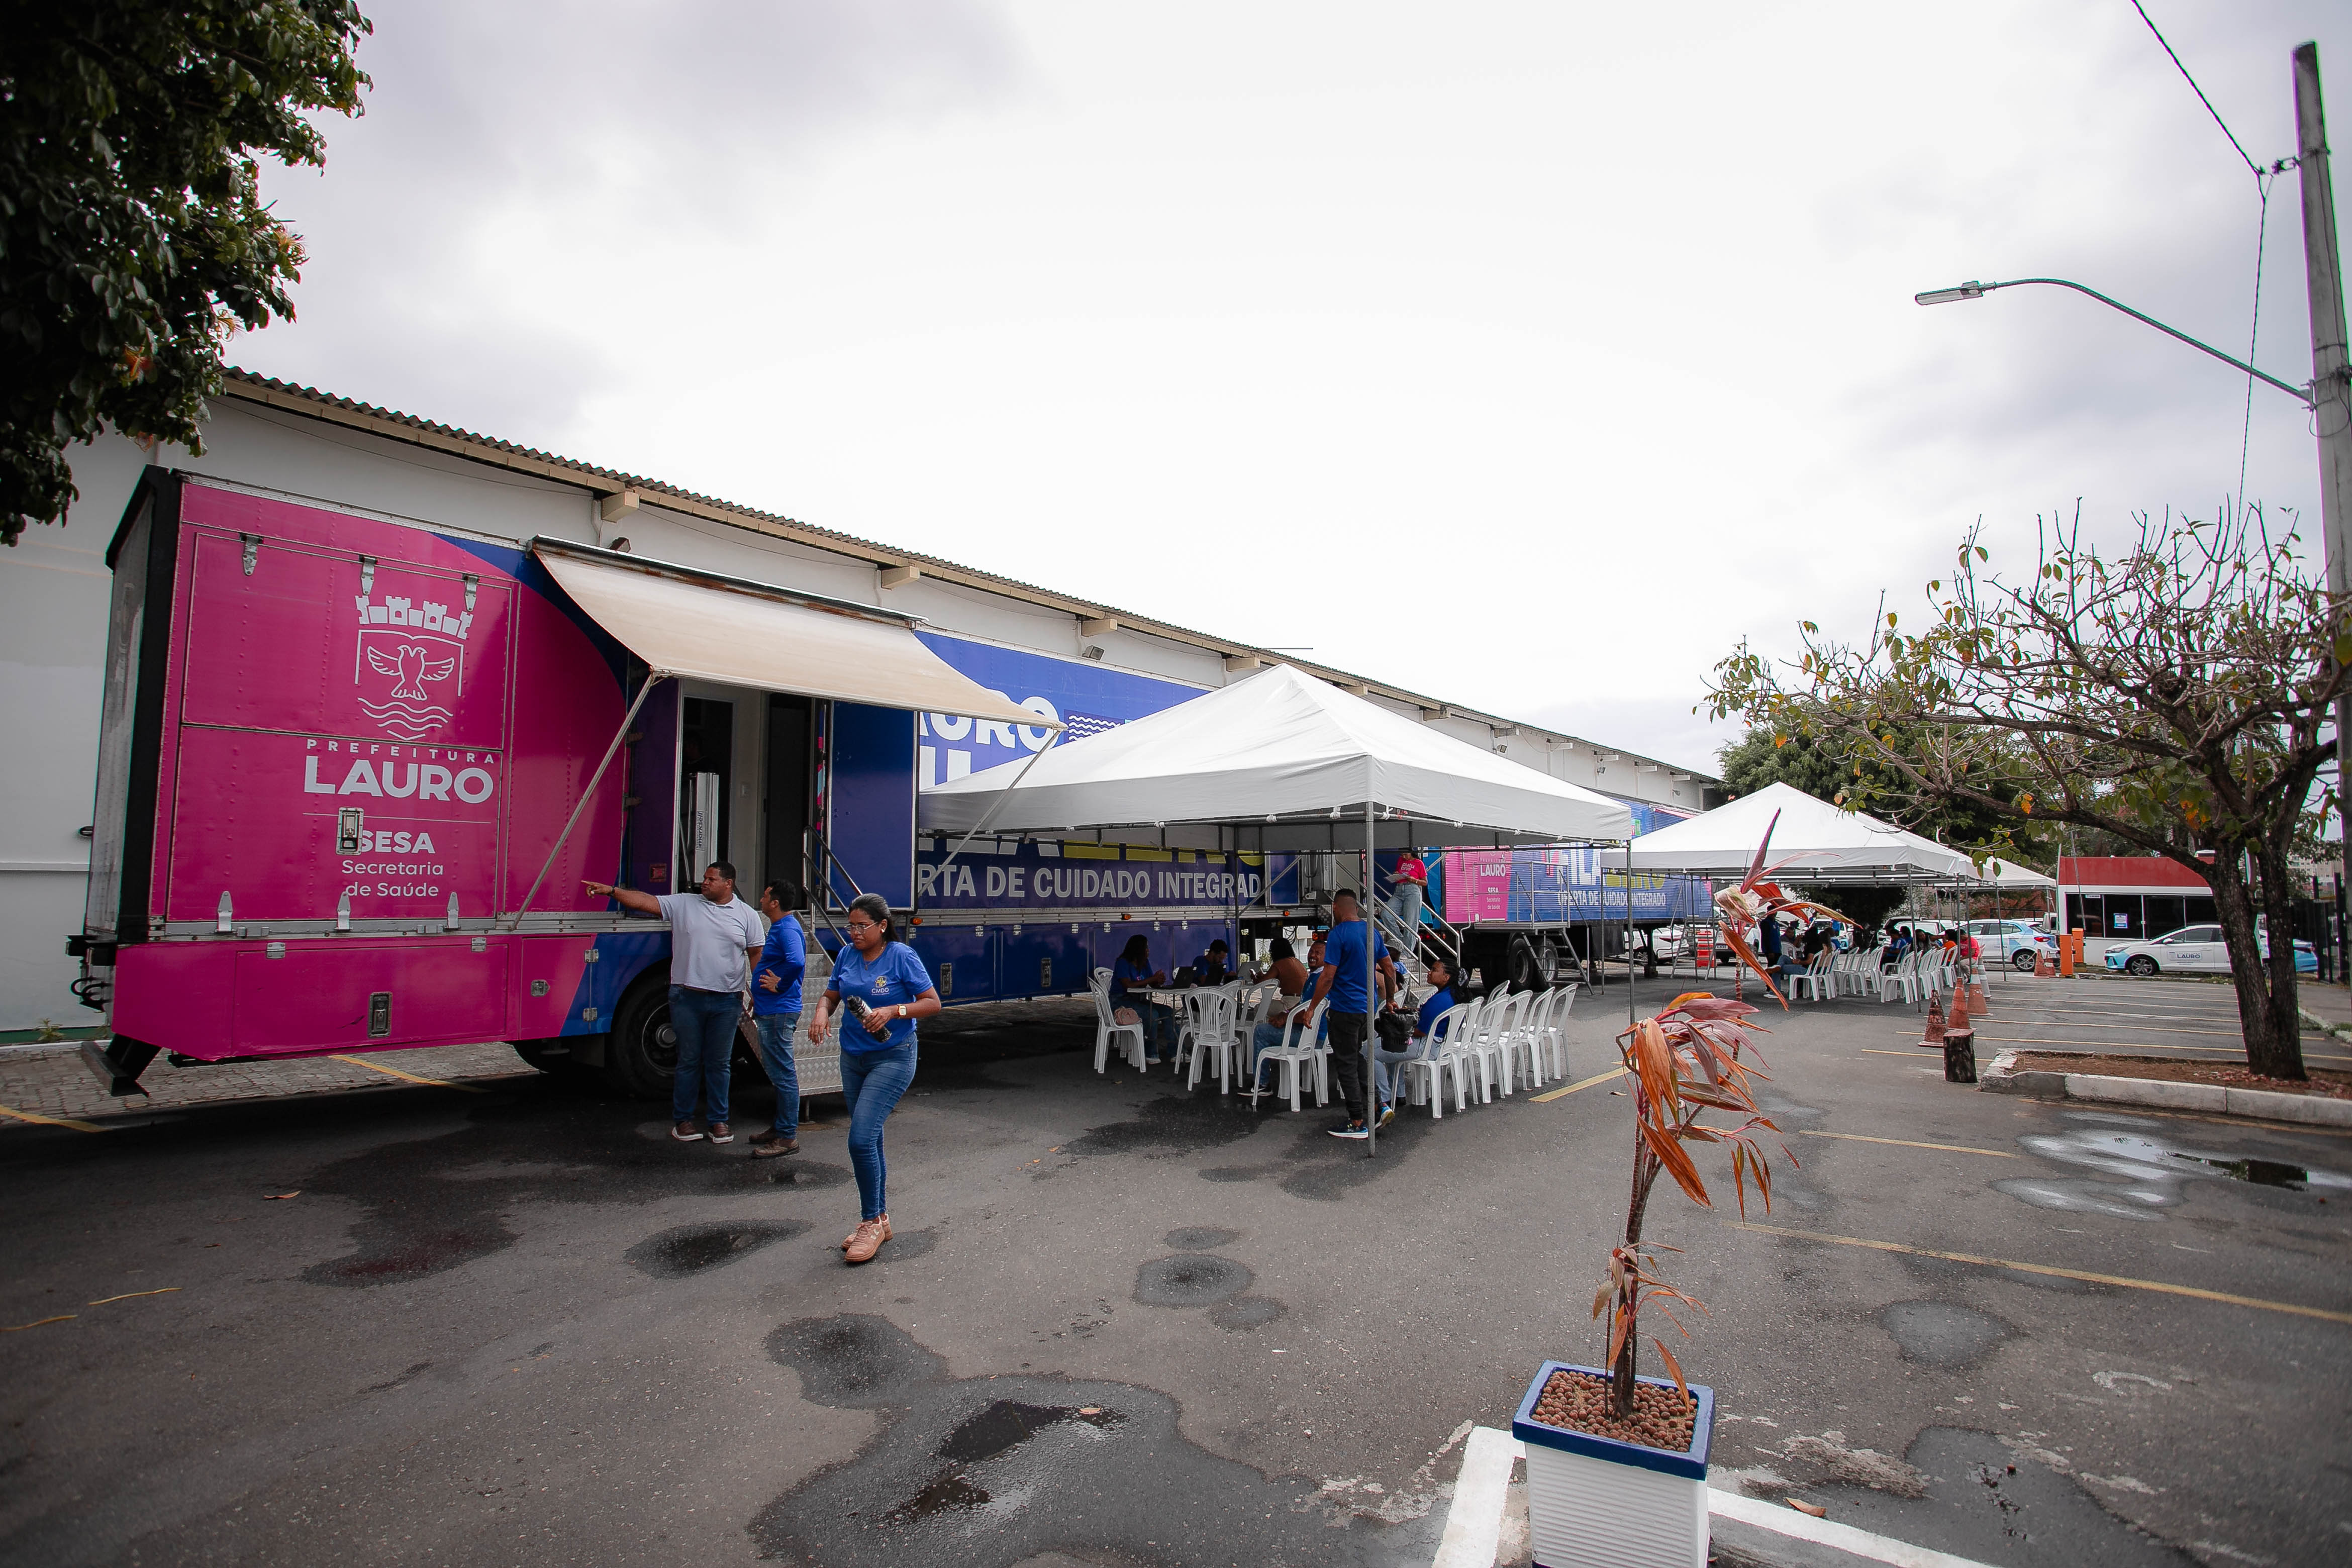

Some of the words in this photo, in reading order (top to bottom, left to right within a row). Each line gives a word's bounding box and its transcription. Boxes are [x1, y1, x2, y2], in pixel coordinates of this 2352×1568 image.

[920, 690, 1059, 753] URO
[307, 739, 494, 763] PREFEITURA
[304, 755, 494, 804] LAURO
[362, 830, 436, 853] SESA
[342, 860, 443, 875] Secretaria
[1480, 863, 1506, 876] LAURO
[346, 881, 371, 896] de
[377, 881, 439, 897] Saúde
[987, 866, 1025, 897] DE
[1034, 868, 1150, 898] CUIDADO
[1158, 872, 1265, 899] INTEGRAD
[1488, 887, 1499, 895] SESA
[1589, 891, 1599, 905] DE
[1631, 893, 1666, 906] INTEGRADO
